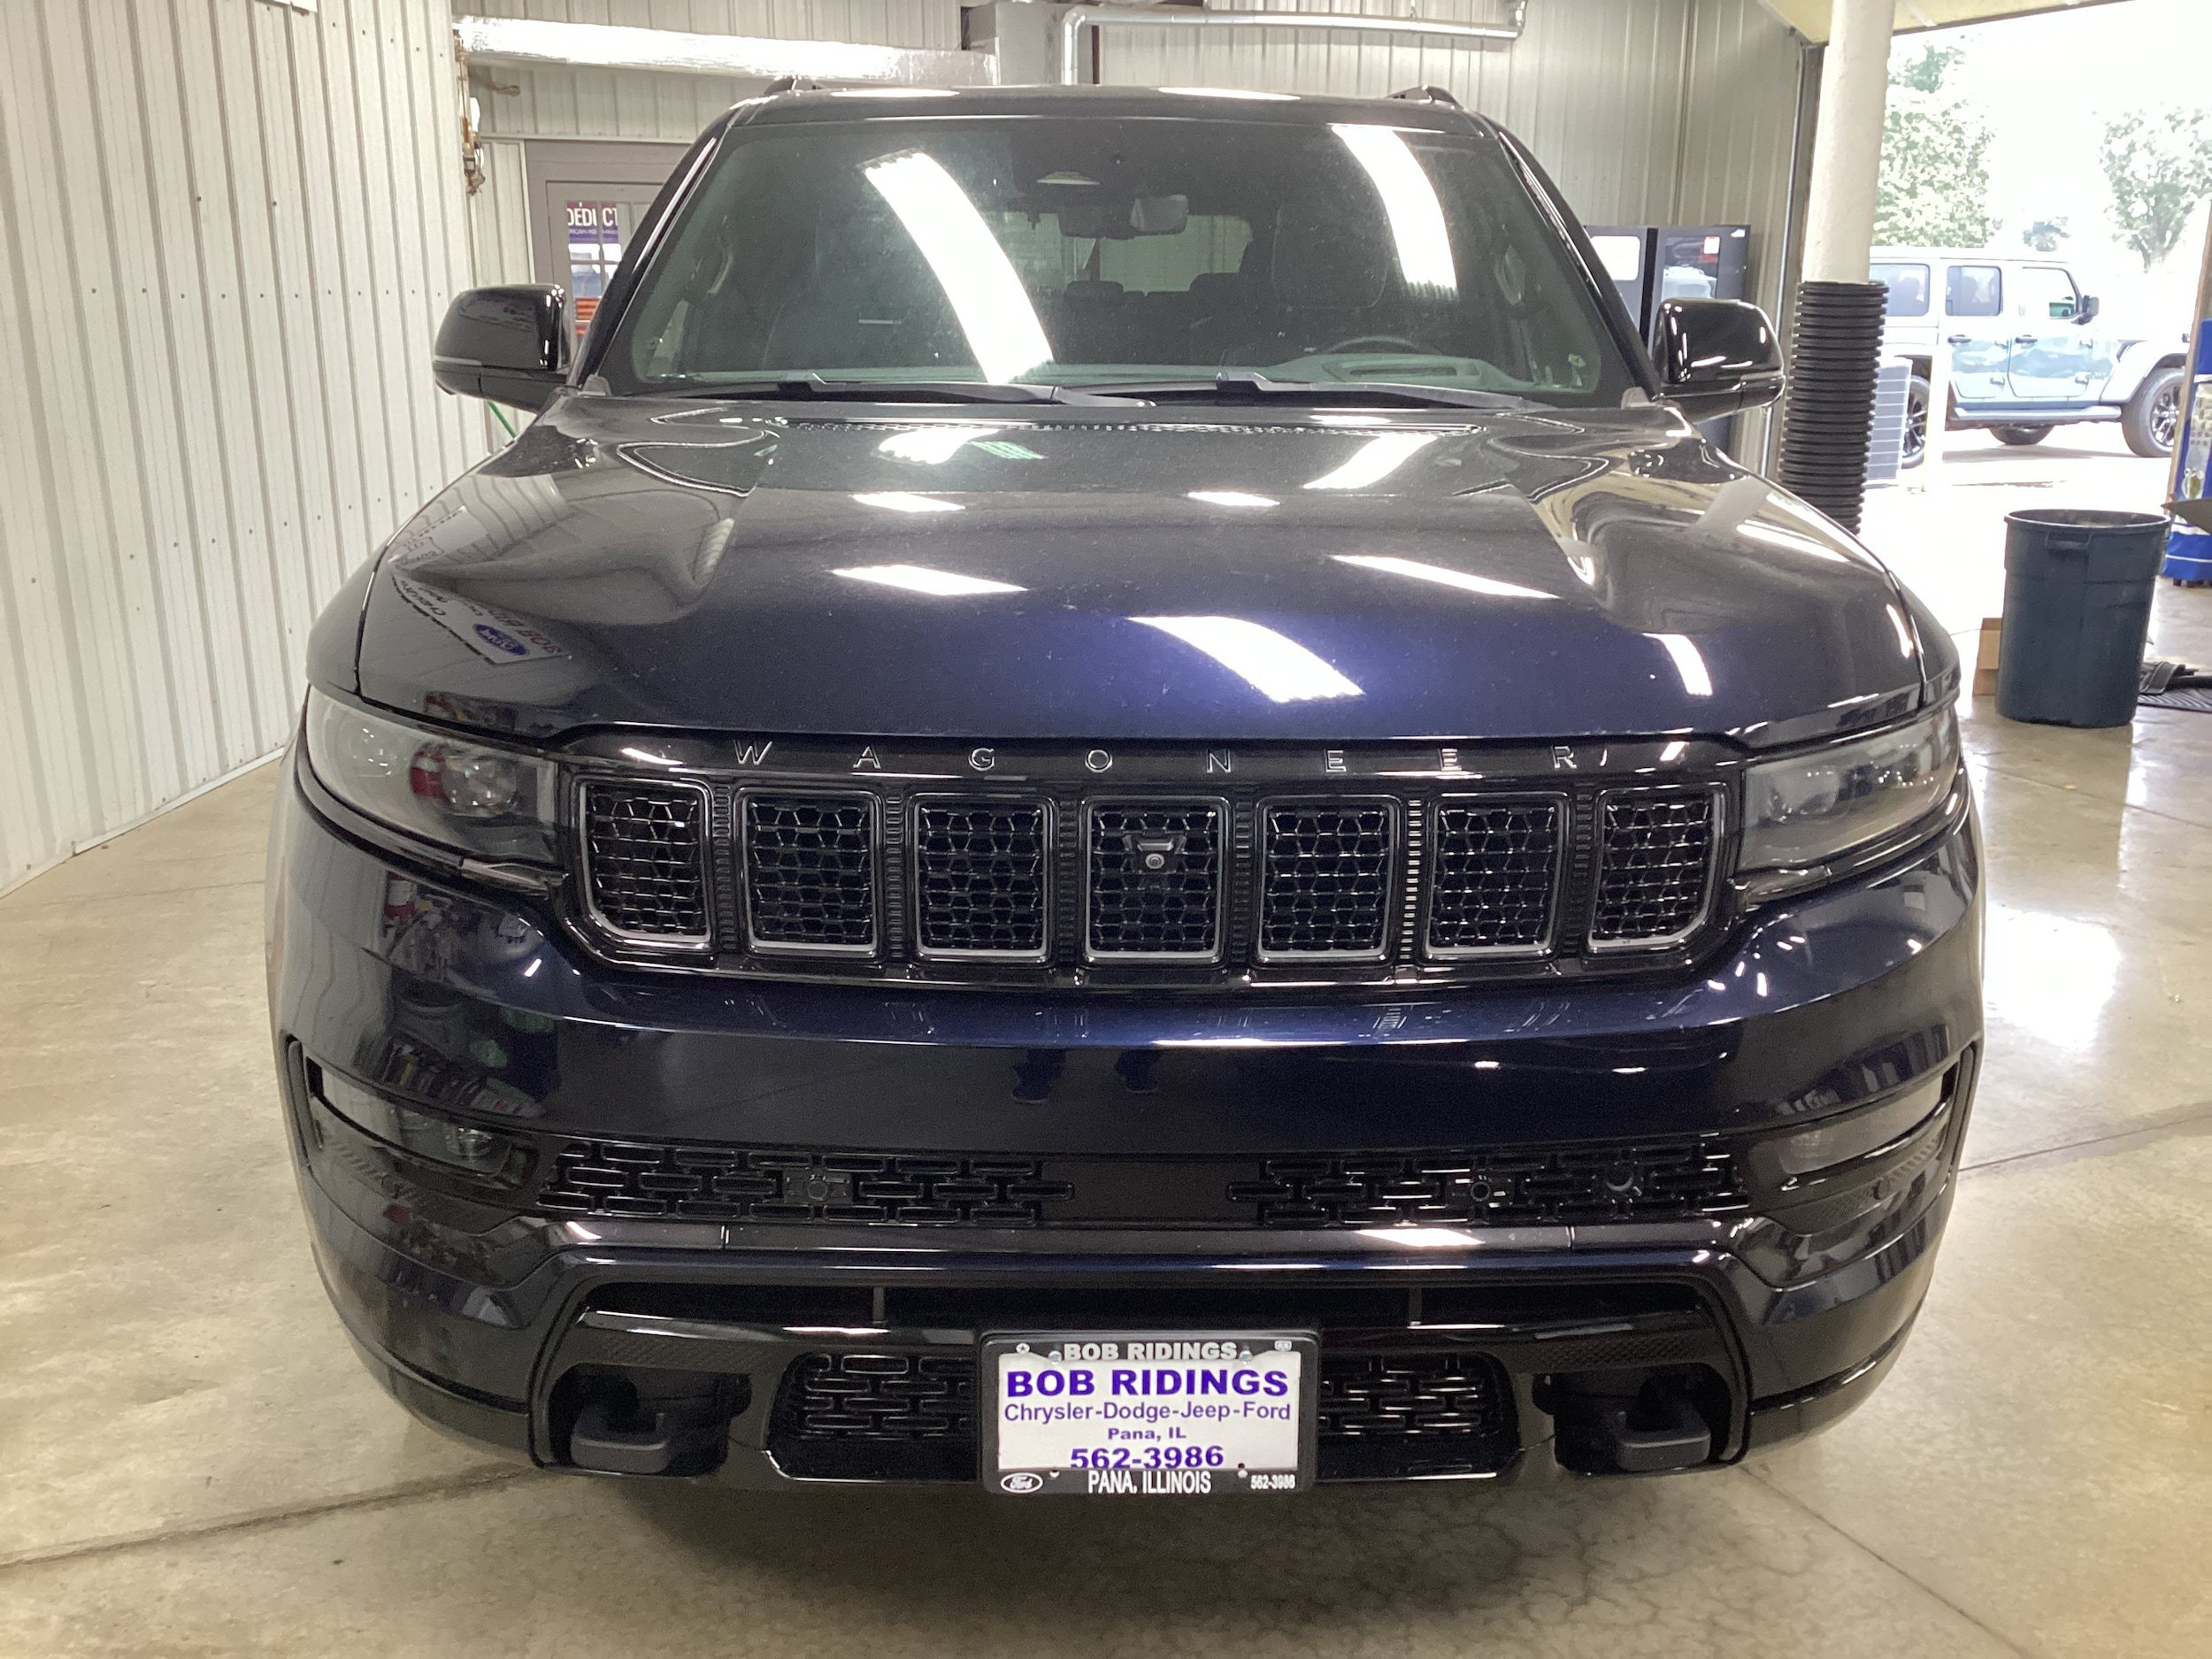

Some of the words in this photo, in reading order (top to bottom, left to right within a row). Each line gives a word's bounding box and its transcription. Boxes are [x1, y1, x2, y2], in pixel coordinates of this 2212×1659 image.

[733, 740, 1577, 773] WAGONEER
[1064, 1342, 1118, 1361] BOB
[1126, 1341, 1237, 1361] RIDINGS
[1007, 1370, 1094, 1397] BOB
[1111, 1369, 1288, 1397] RIDINGS
[1108, 1427, 1161, 1442] Pana,
[1168, 1426, 1187, 1440] IL
[1070, 1445, 1224, 1469] 562-3986
[1142, 1471, 1211, 1494] ILLINOIS
[1250, 1474, 1296, 1490] 562-3986
